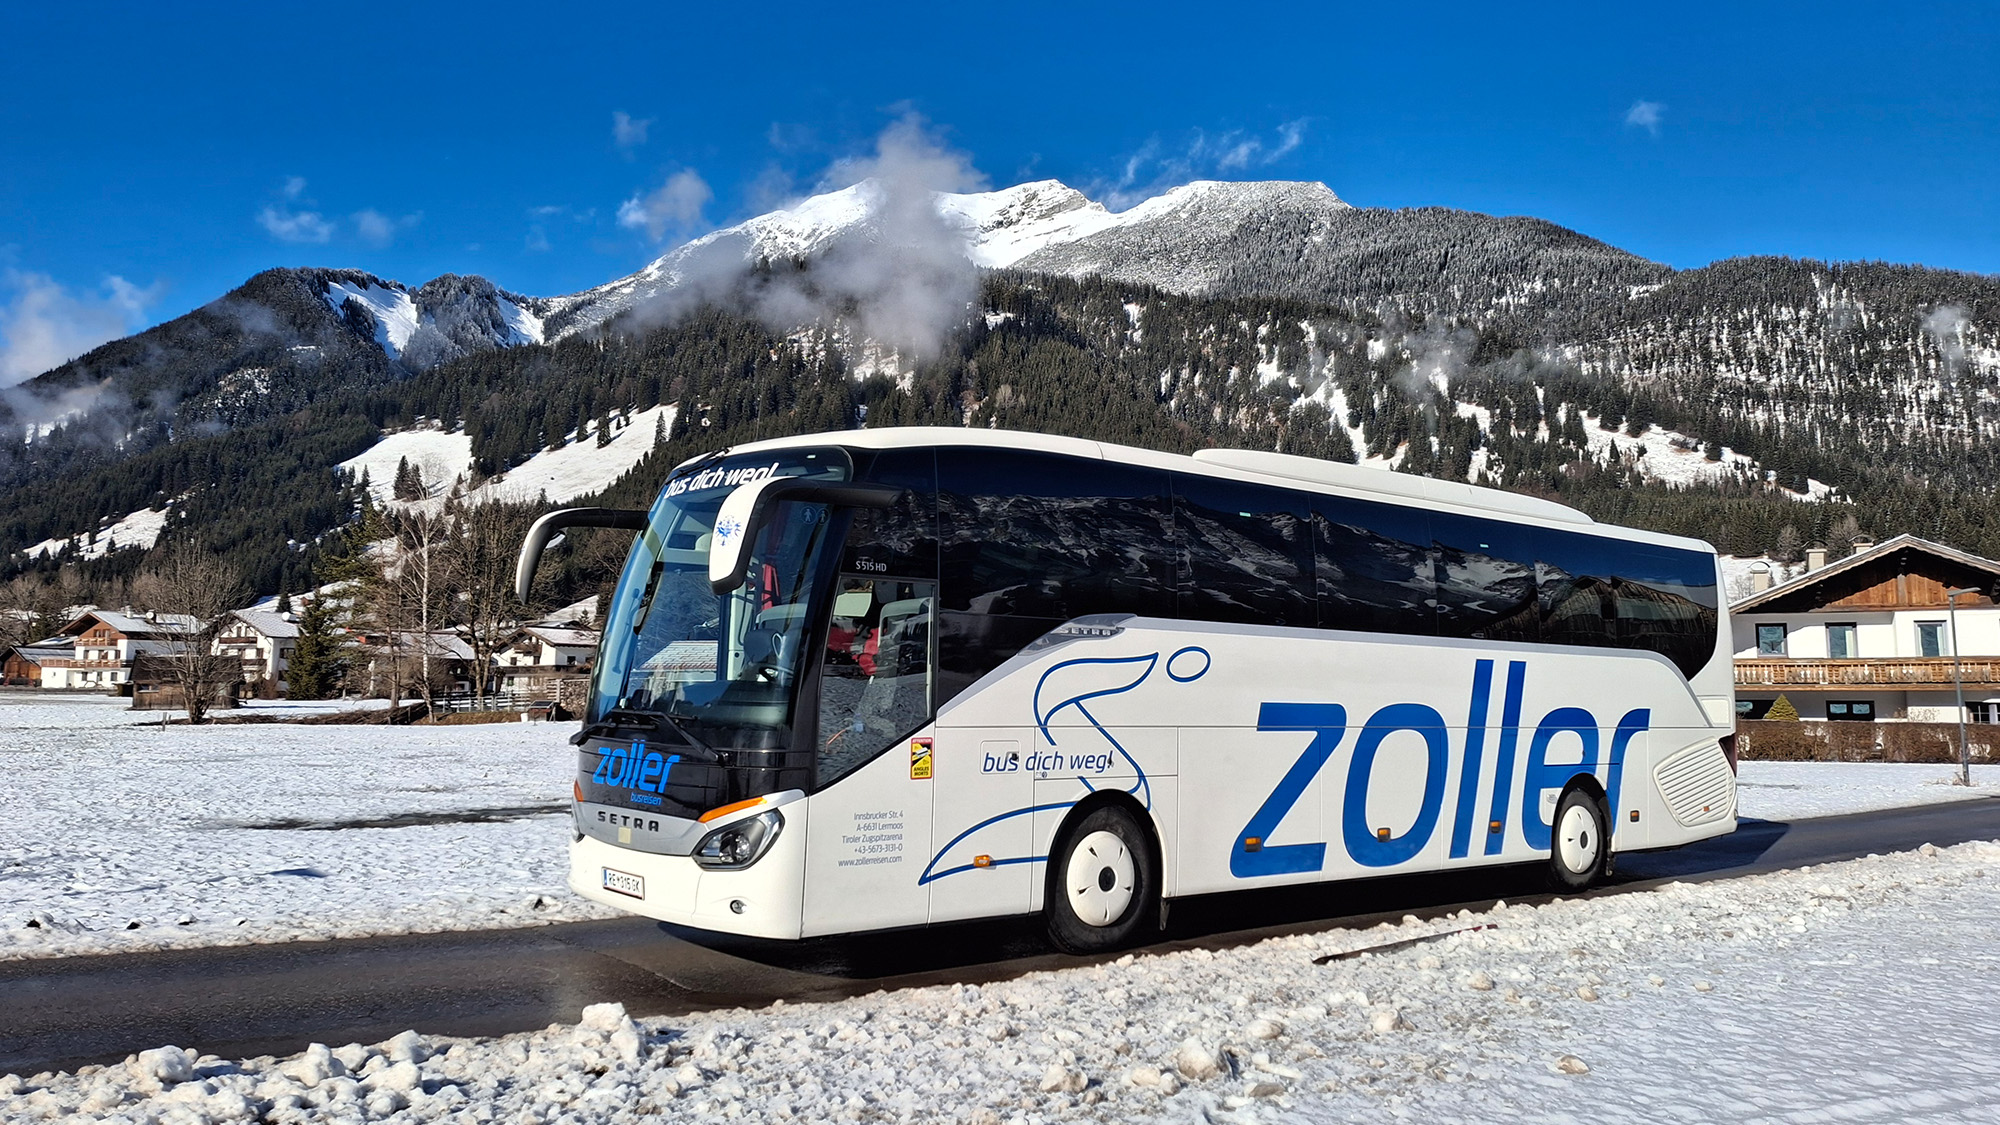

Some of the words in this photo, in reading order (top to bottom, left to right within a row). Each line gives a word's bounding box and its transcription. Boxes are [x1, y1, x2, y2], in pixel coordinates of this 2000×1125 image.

[664, 477, 691, 499] bus
[689, 467, 725, 491] dich
[856, 560, 861, 570] S
[861, 561, 874, 571] 515
[875, 562, 887, 572] HD
[593, 738, 681, 793] zoller
[983, 752, 1019, 772] bus
[1025, 751, 1064, 771] dich
[1070, 750, 1114, 774] weg!
[1229, 658, 1651, 878] zoller
[631, 792, 662, 806] busreisen
[597, 810, 660, 833] SETRA
[854, 811, 888, 820] Innsbrucker
[888, 810, 899, 819] Str.
[899, 810, 904, 818] 4
[856, 822, 877, 831] A-6631
[878, 822, 904, 831] Lermoos
[842, 835, 861, 844] Tiroler
[861, 833, 903, 844] Zugspitzarena
[838, 855, 903, 867] www.zollerreisen.com
